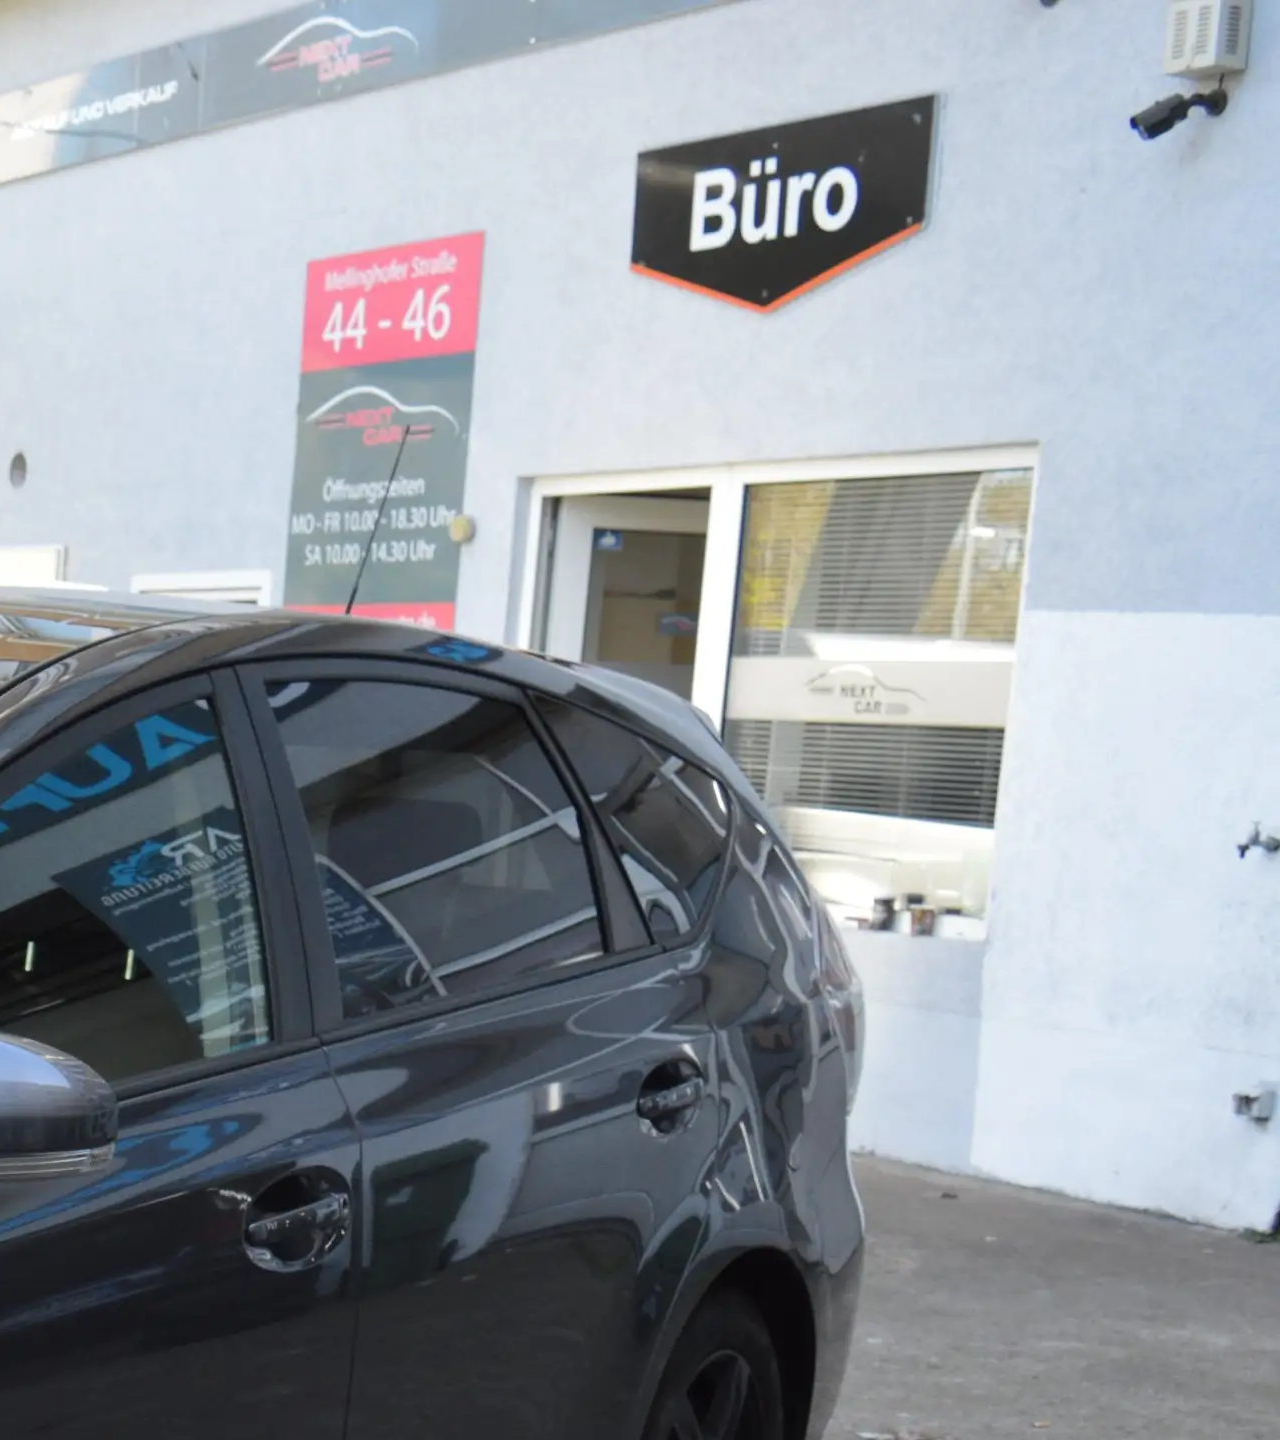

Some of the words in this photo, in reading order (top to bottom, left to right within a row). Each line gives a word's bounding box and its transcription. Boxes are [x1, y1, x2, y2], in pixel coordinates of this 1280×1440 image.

[689, 157, 858, 252] Büro
[321, 296, 368, 354] 44
[377, 319, 393, 329] -
[402, 284, 451, 342] 46
[346, 406, 394, 429] NEXT
[362, 425, 403, 446] CAR
[291, 512, 315, 535] MO
[323, 511, 341, 533] FR
[390, 506, 427, 529] 18.30
[429, 504, 457, 528] Uhr
[304, 544, 322, 567] SA
[324, 543, 361, 565] 10.00
[371, 540, 408, 562] 14.30
[409, 538, 437, 561] Uhr
[839, 683, 876, 698] NEXT
[854, 700, 884, 715] CAR
